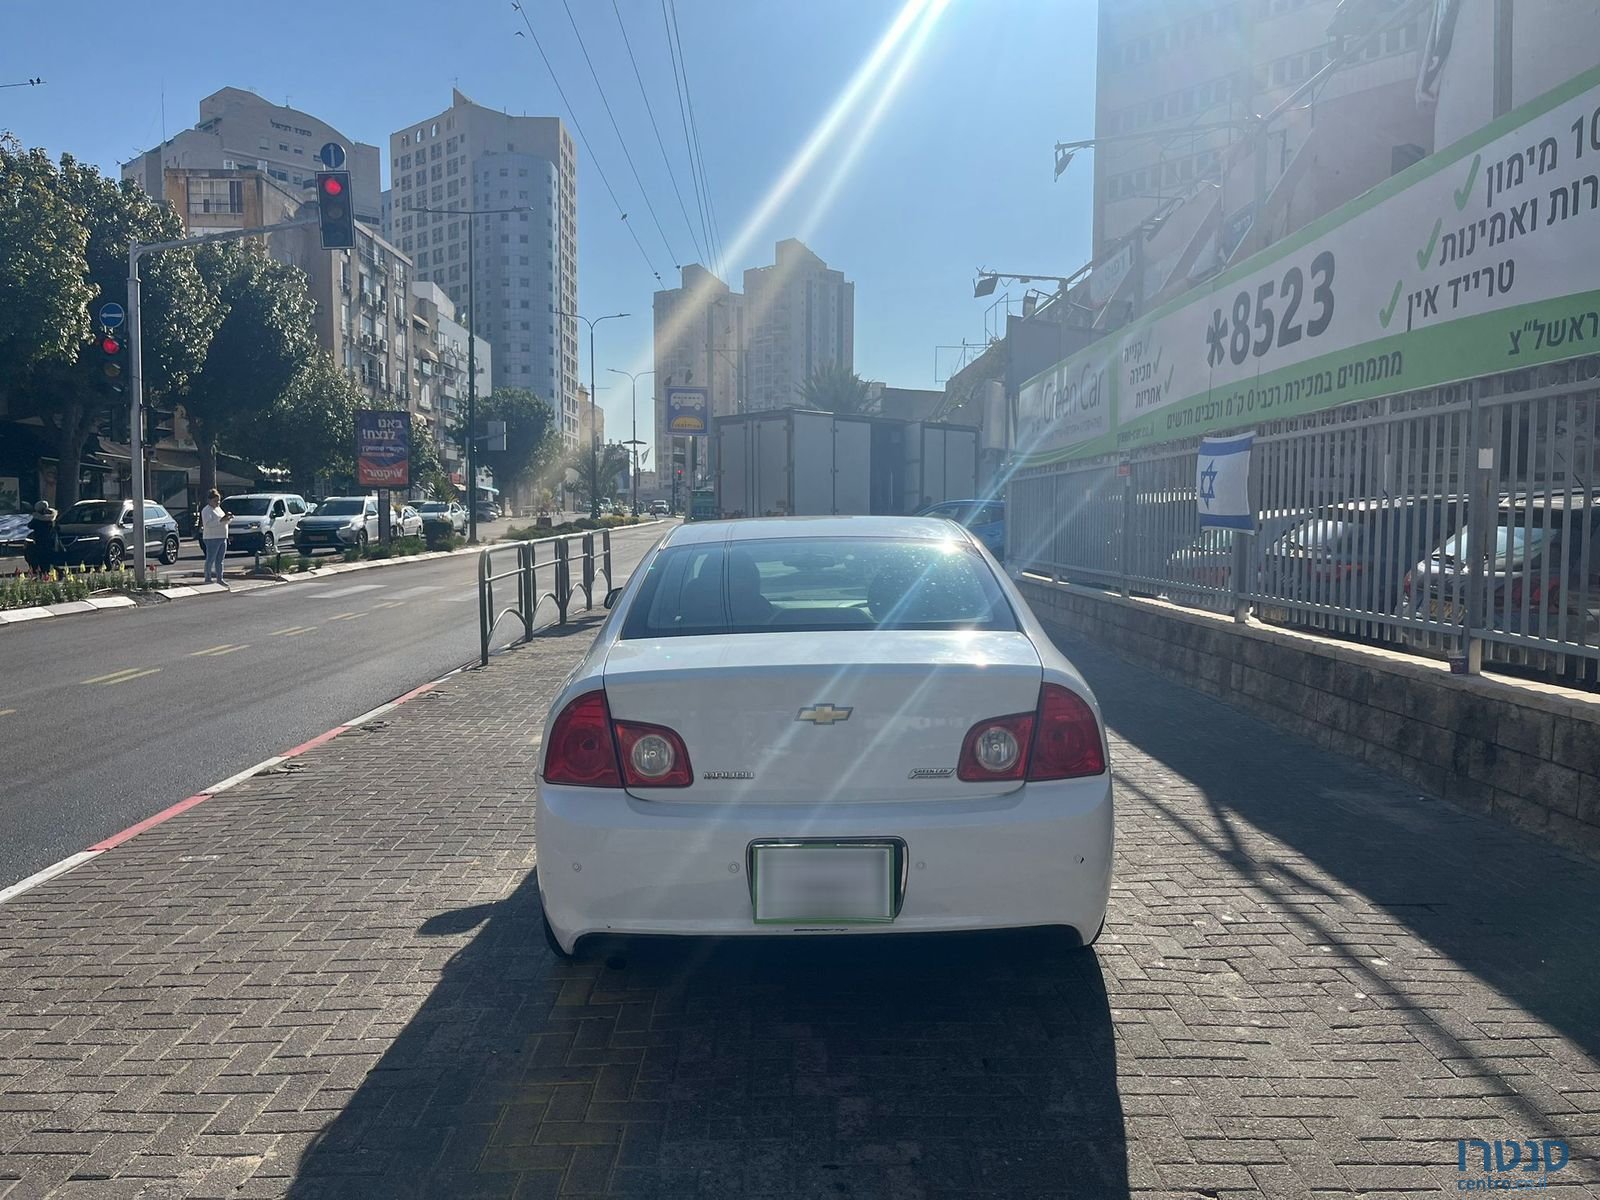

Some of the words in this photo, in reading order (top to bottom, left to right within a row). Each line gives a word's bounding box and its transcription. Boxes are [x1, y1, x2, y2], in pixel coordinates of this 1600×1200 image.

[1486, 136, 1558, 209] מימון
[1439, 197, 1538, 266] ואמינות
[1447, 258, 1515, 309] טרייד
[1406, 284, 1440, 333] אין
[1080, 362, 1105, 410] Car
[1129, 362, 1151, 385] מכירה
[1285, 370, 1333, 403] במכירת
[1337, 350, 1403, 390] מתמחים
[1135, 384, 1162, 409] אחריות
[1194, 398, 1223, 423] ורכבים
[1257, 386, 1281, 410] רכבי
[1166, 408, 1193, 430] חדשים
